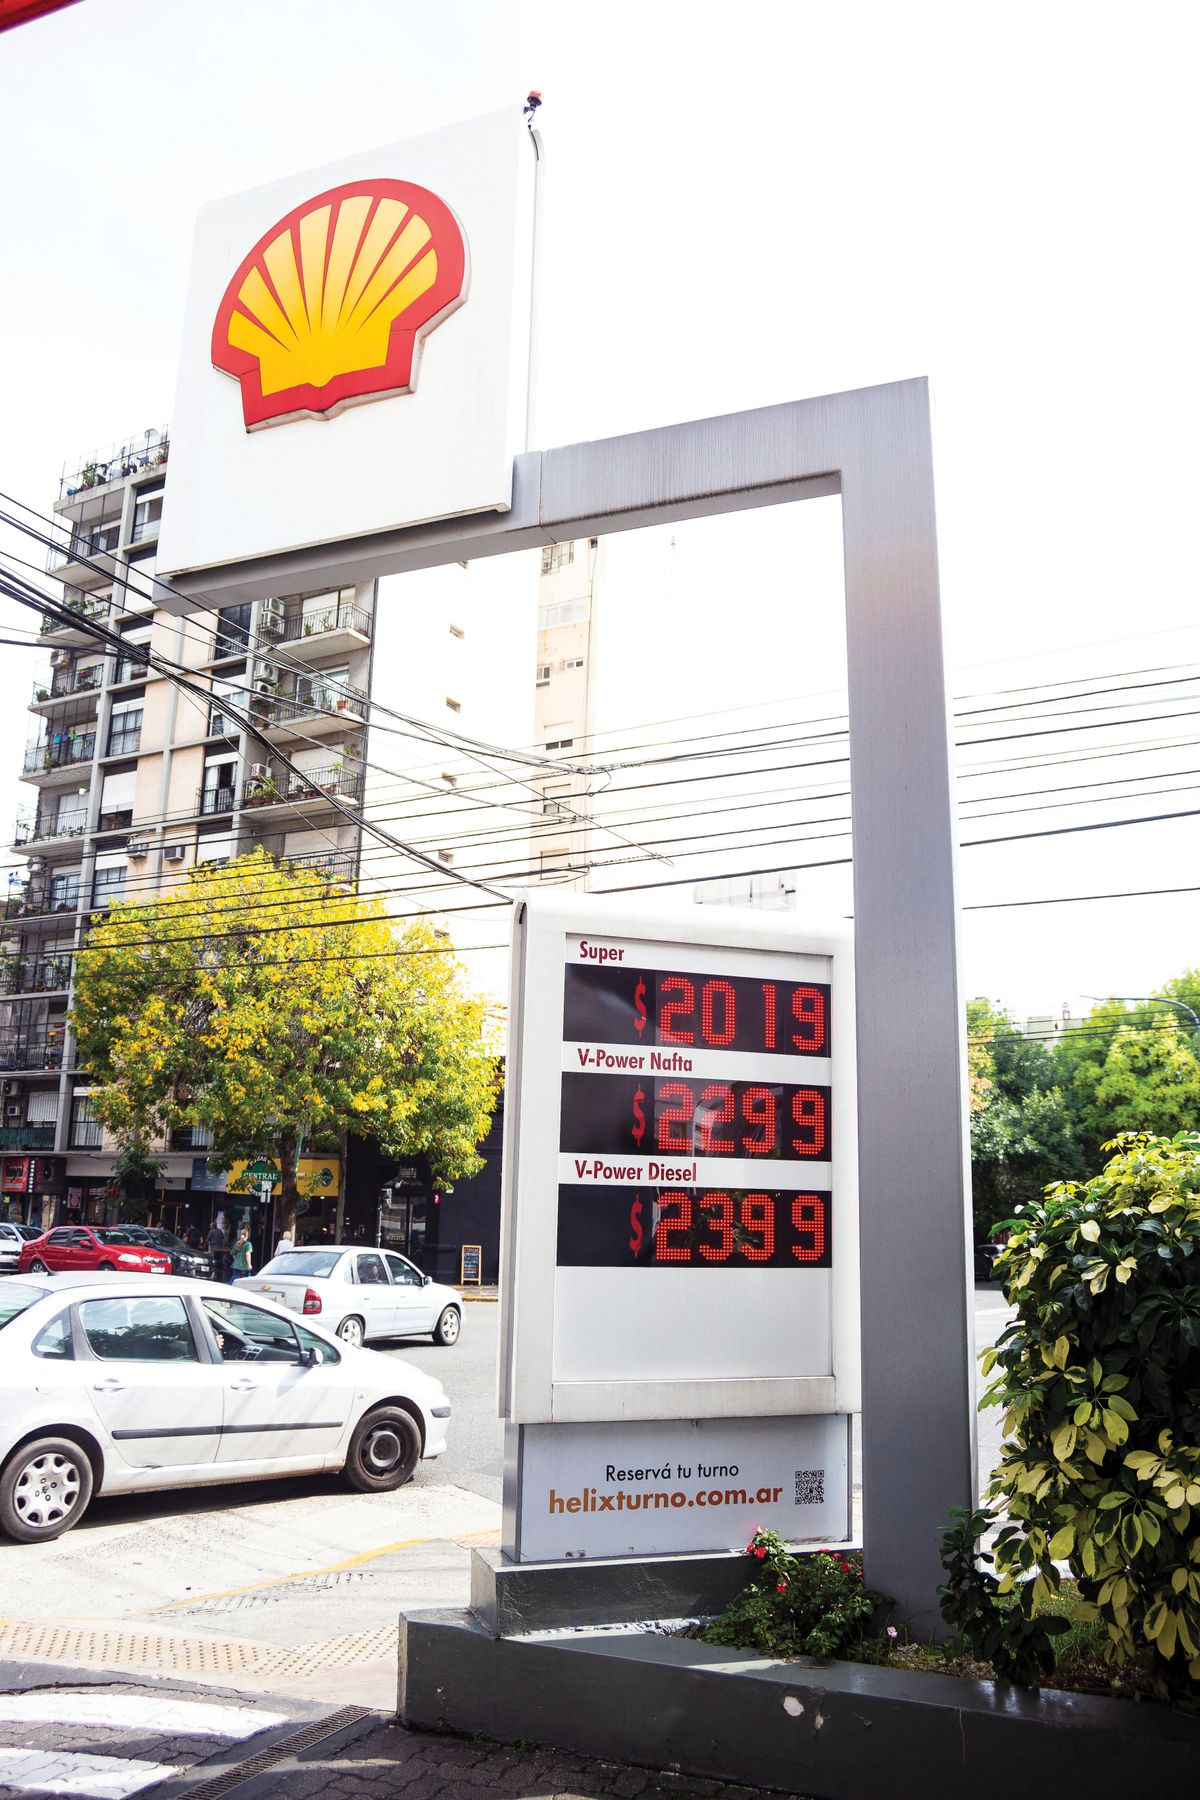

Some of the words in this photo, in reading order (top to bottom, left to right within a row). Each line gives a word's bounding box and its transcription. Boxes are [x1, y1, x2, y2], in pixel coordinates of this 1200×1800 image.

[579, 941, 625, 963] Super
[577, 1048, 644, 1069] V-Power
[650, 1052, 693, 1072] Nafta
[574, 1160, 643, 1181] V-Power
[648, 1162, 697, 1182] Diesel
[606, 1463, 672, 1483] Reservá
[677, 1464, 692, 1479] tu
[698, 1463, 740, 1479] turno
[549, 1485, 783, 1515] helixturno.com.ar
